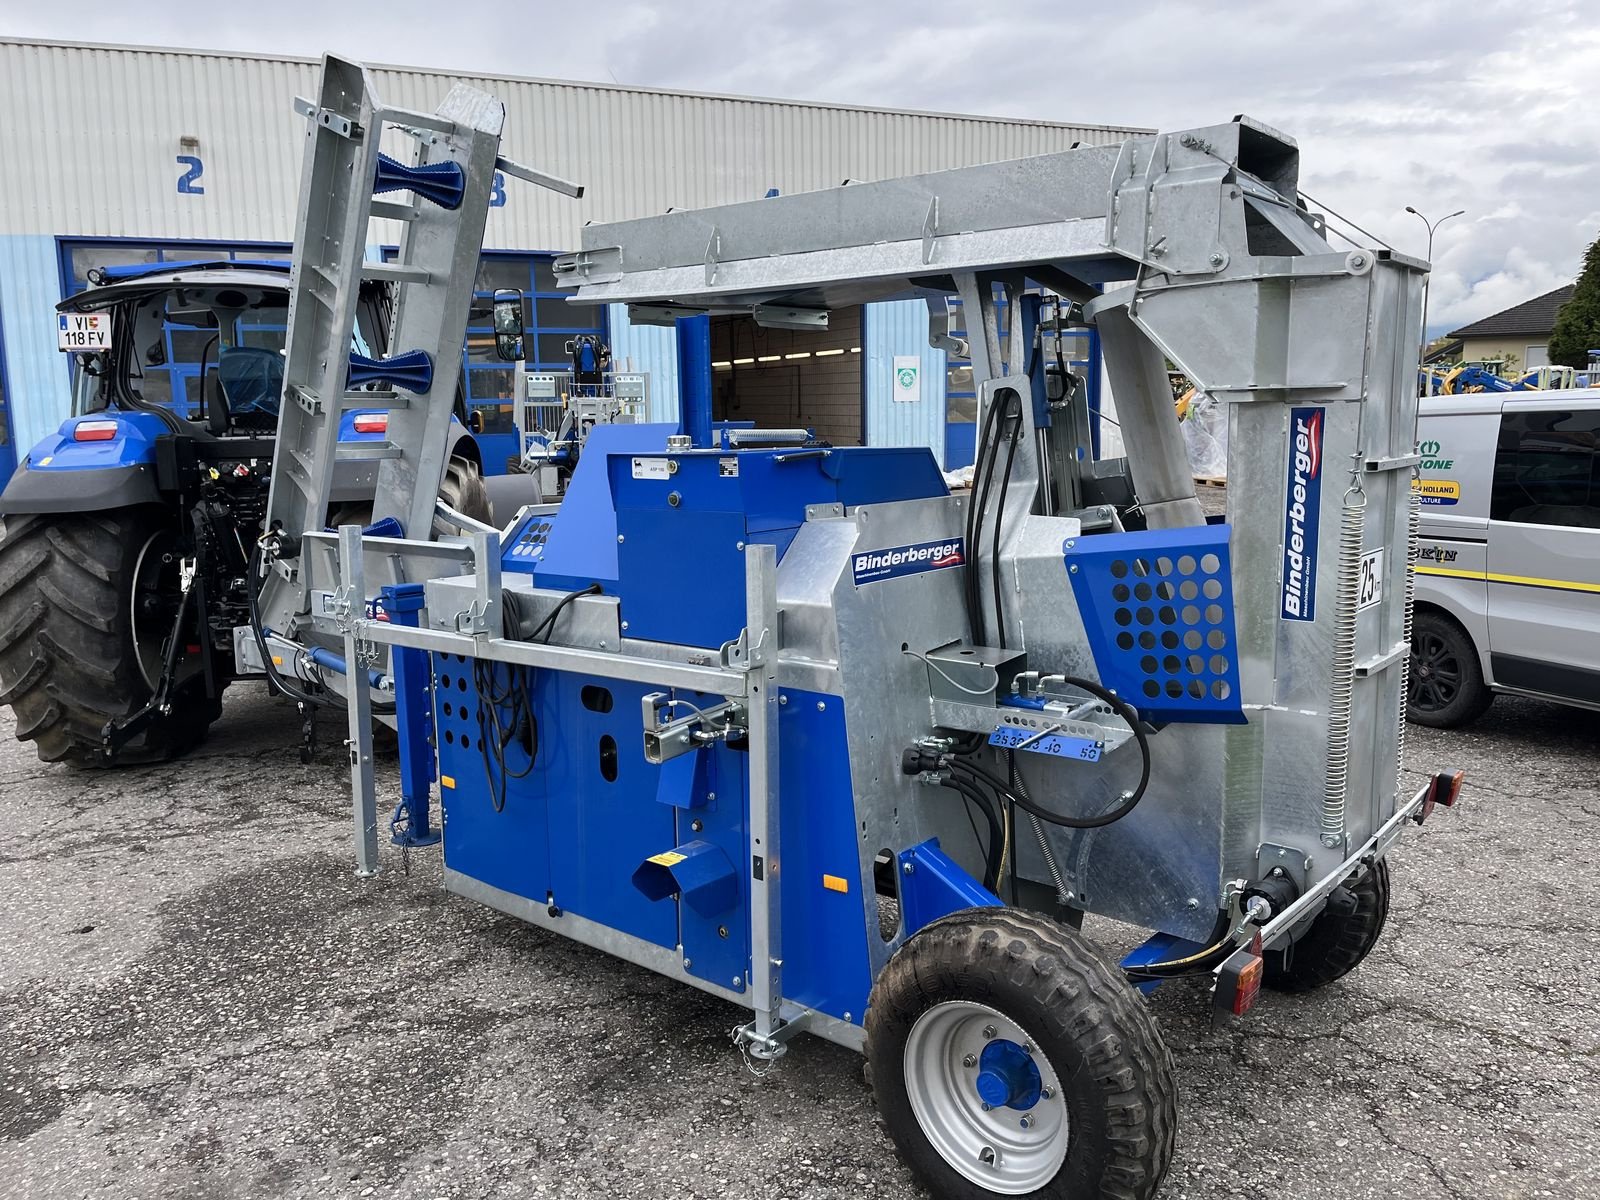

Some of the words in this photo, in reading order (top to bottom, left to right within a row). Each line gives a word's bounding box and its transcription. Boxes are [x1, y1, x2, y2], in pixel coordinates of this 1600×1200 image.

[176, 155, 204, 194] 2
[75, 316, 87, 330] VI
[65, 331, 85, 345] 118
[88, 331, 104, 345] FV
[1423, 486, 1454, 494] HOLLAND
[1285, 418, 1310, 617] Binderberger
[855, 543, 959, 572] Binderberger
[1361, 558, 1375, 604] 25
[993, 734, 1008, 745] 25
[1044, 743, 1061, 754] 40
[1080, 748, 1097, 760] 50
